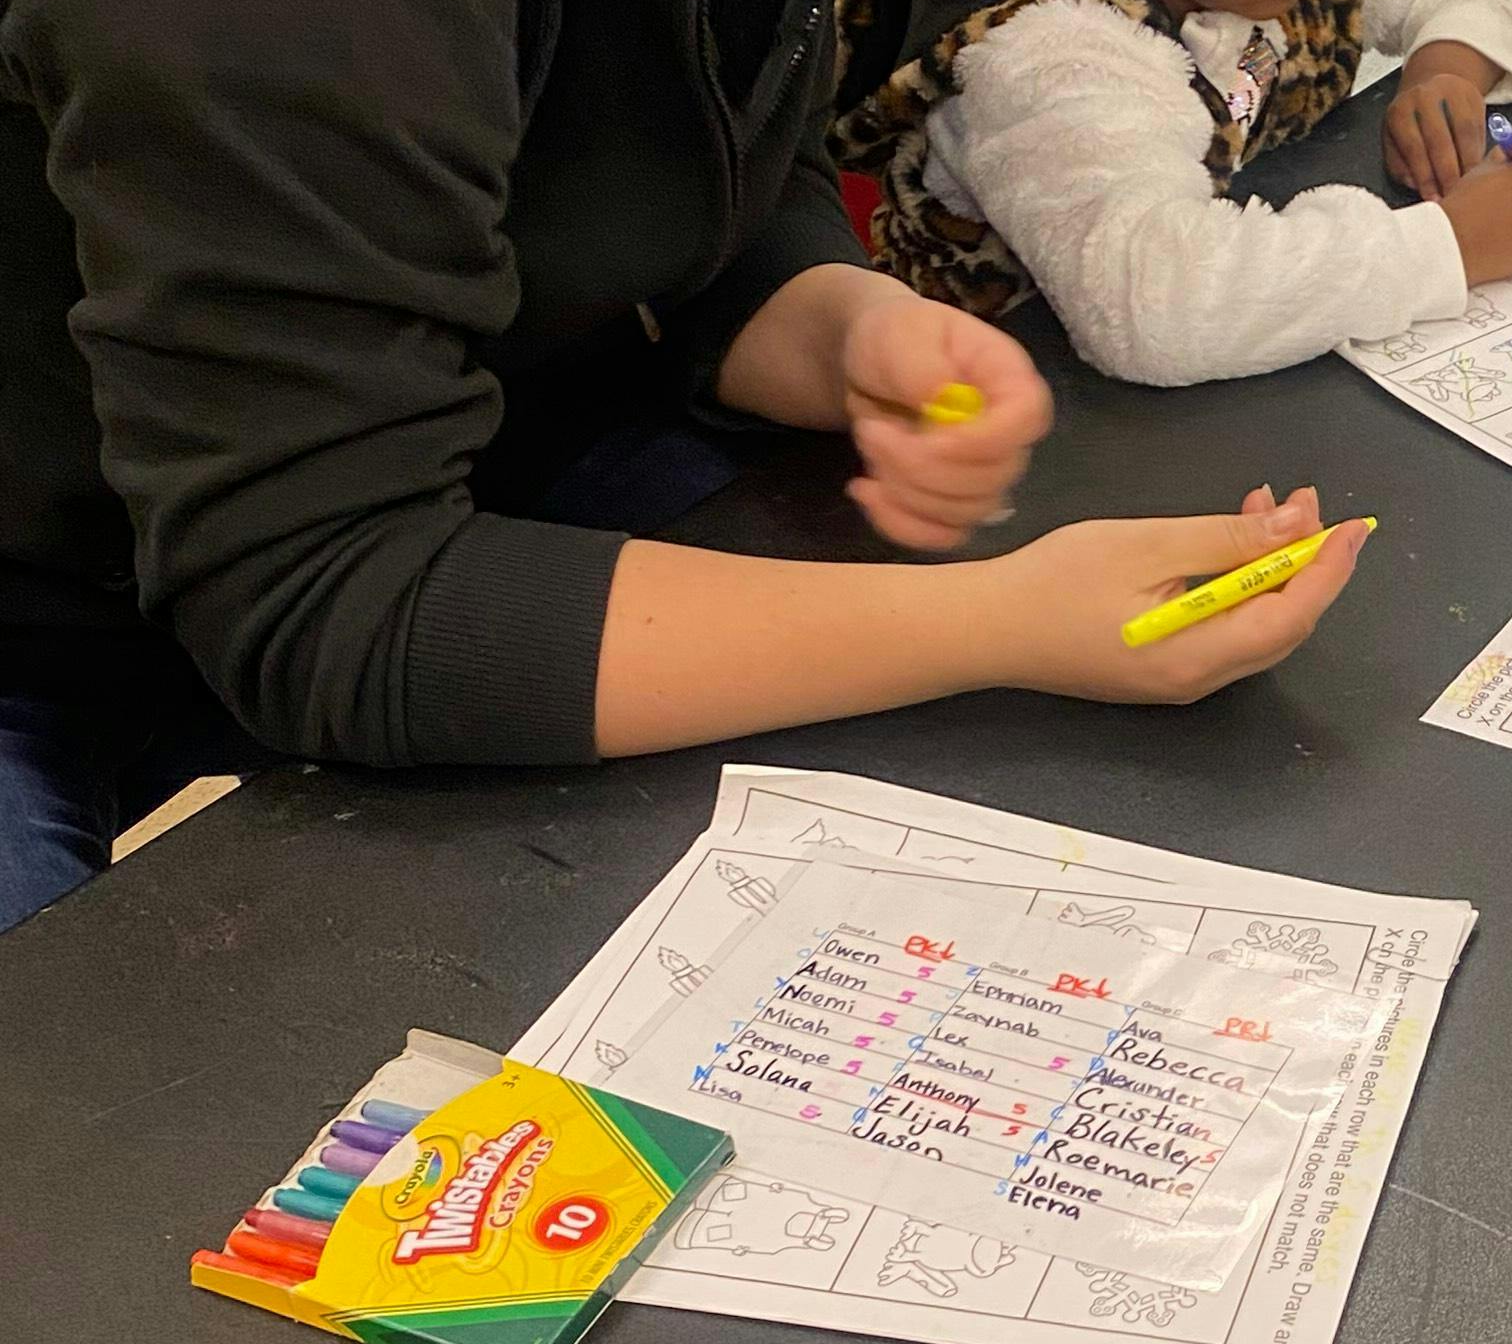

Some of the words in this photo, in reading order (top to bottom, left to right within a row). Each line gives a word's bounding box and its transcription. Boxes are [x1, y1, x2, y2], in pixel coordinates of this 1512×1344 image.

[1457, 690, 1490, 719] Circle
[1480, 674, 1502, 694] the
[1477, 712, 1494, 728] X
[1490, 701, 1507, 717] on
[1386, 927, 1404, 939] X
[824, 939, 880, 965] Owen
[795, 960, 867, 991] Adam
[1394, 970, 1415, 994] the
[779, 984, 857, 1014] Noemi
[972, 980, 1063, 1015] Ephriam
[763, 1006, 830, 1035] Micah
[932, 1027, 970, 1048] Lex
[951, 1005, 1040, 1038] Zaynab
[1120, 1020, 1163, 1043] Ava
[739, 1029, 831, 1065] Penelope
[1374, 1055, 1389, 1068] in
[502, 1073, 521, 1090] 3+
[726, 1049, 814, 1093] Solana
[915, 1050, 995, 1083] Isabel
[1110, 1037, 1246, 1093] Rebecca
[698, 1076, 744, 1102] Lisa
[892, 1072, 981, 1114] Anthony
[1355, 1070, 1380, 1106] each
[874, 1094, 972, 1138] Elijah
[1075, 1087, 1212, 1142] Cristian
[1346, 1109, 1368, 1135] row
[851, 1116, 944, 1162] Jason
[1065, 1112, 1200, 1175] Blakeley
[1312, 1120, 1338, 1151] that
[1043, 1138, 1196, 1199] Roemarie
[1335, 1139, 1360, 1168] that
[394, 1147, 435, 1206] Crayola
[489, 1137, 554, 1230] Crayons
[1019, 1166, 1104, 1204] Jolene
[1298, 1152, 1326, 1190] does
[1325, 1170, 1346, 1197] are
[393, 1119, 542, 1263] Twistables
[1007, 1186, 1082, 1220] Elena
[1288, 1193, 1309, 1219] not
[546, 1204, 597, 1242] 10
[1314, 1199, 1339, 1225] the
[1267, 1221, 1299, 1274] match.
[1296, 1226, 1326, 1276] same.
[1280, 1282, 1312, 1327] Draw
